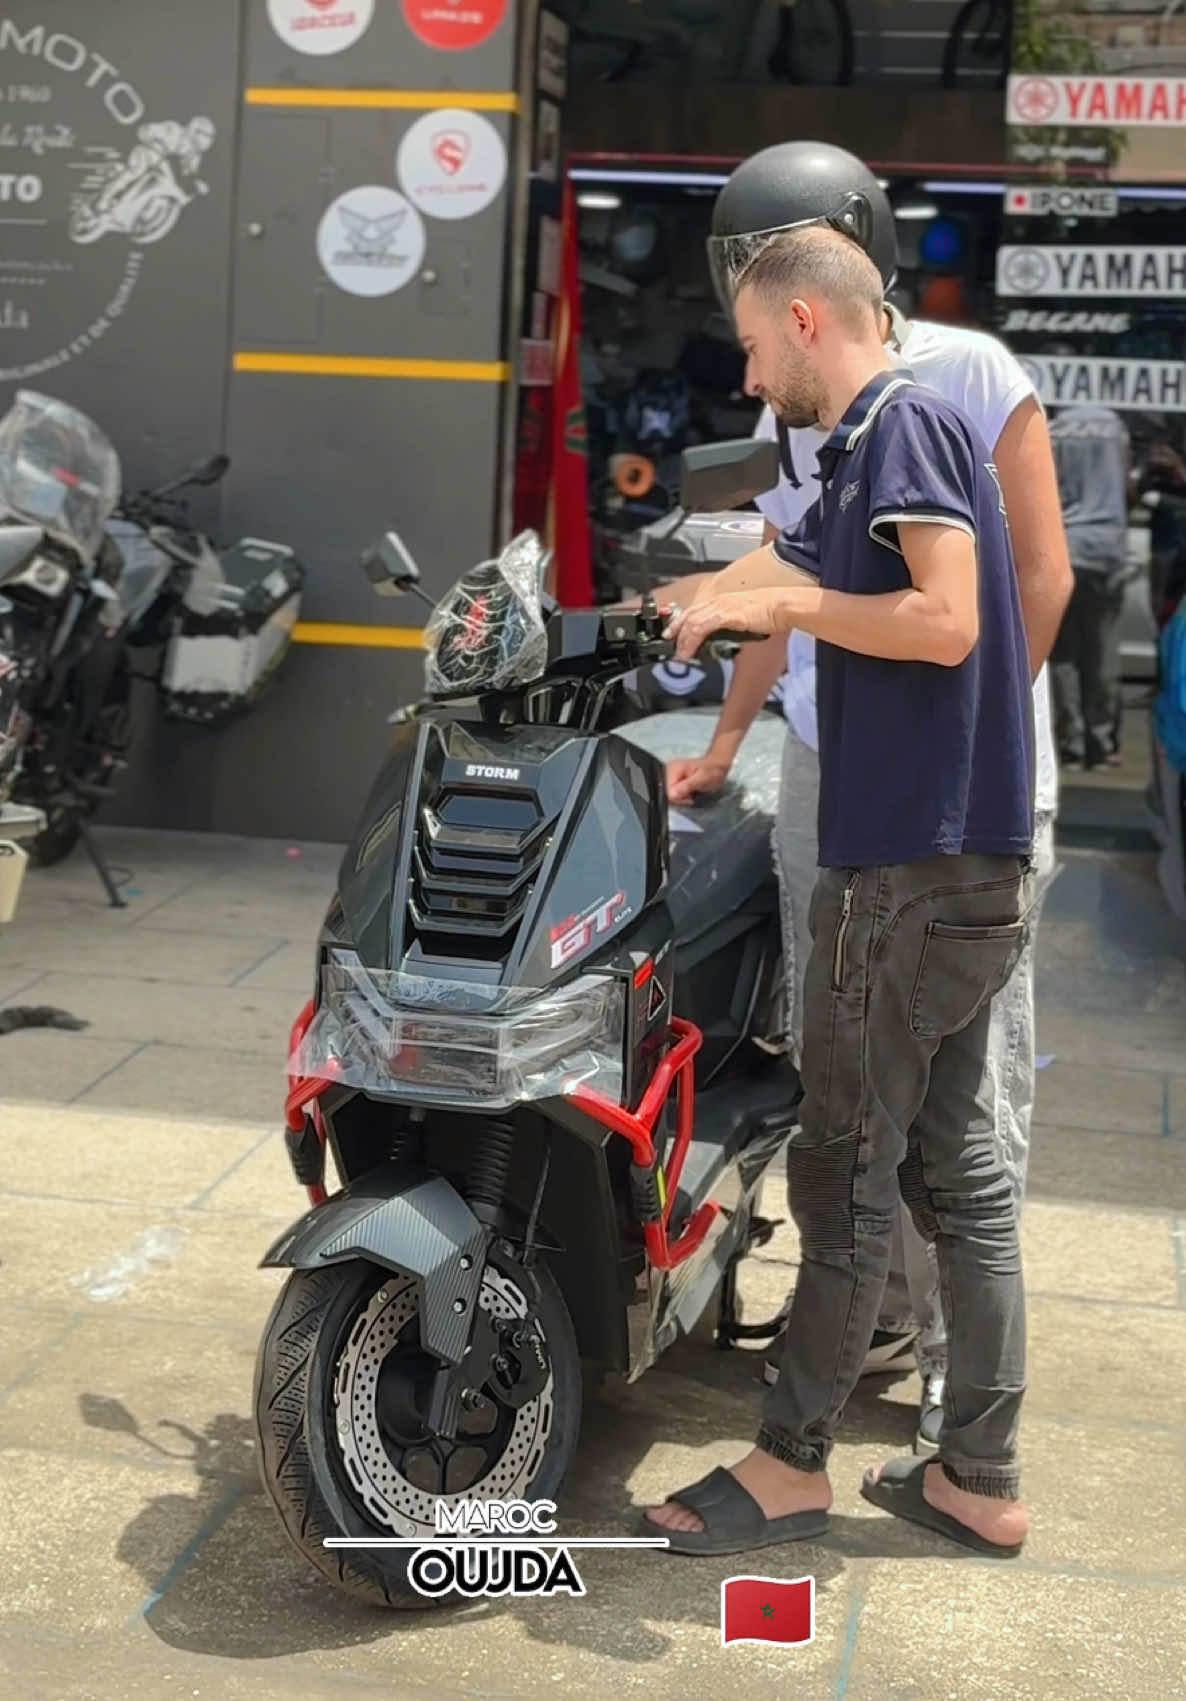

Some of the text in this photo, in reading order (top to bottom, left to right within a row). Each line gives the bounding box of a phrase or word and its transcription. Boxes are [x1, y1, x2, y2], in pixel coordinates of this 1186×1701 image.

[0, 19, 144, 125] MOTO
[465, 764, 520, 780] STORM
[550, 890, 626, 969] GT
